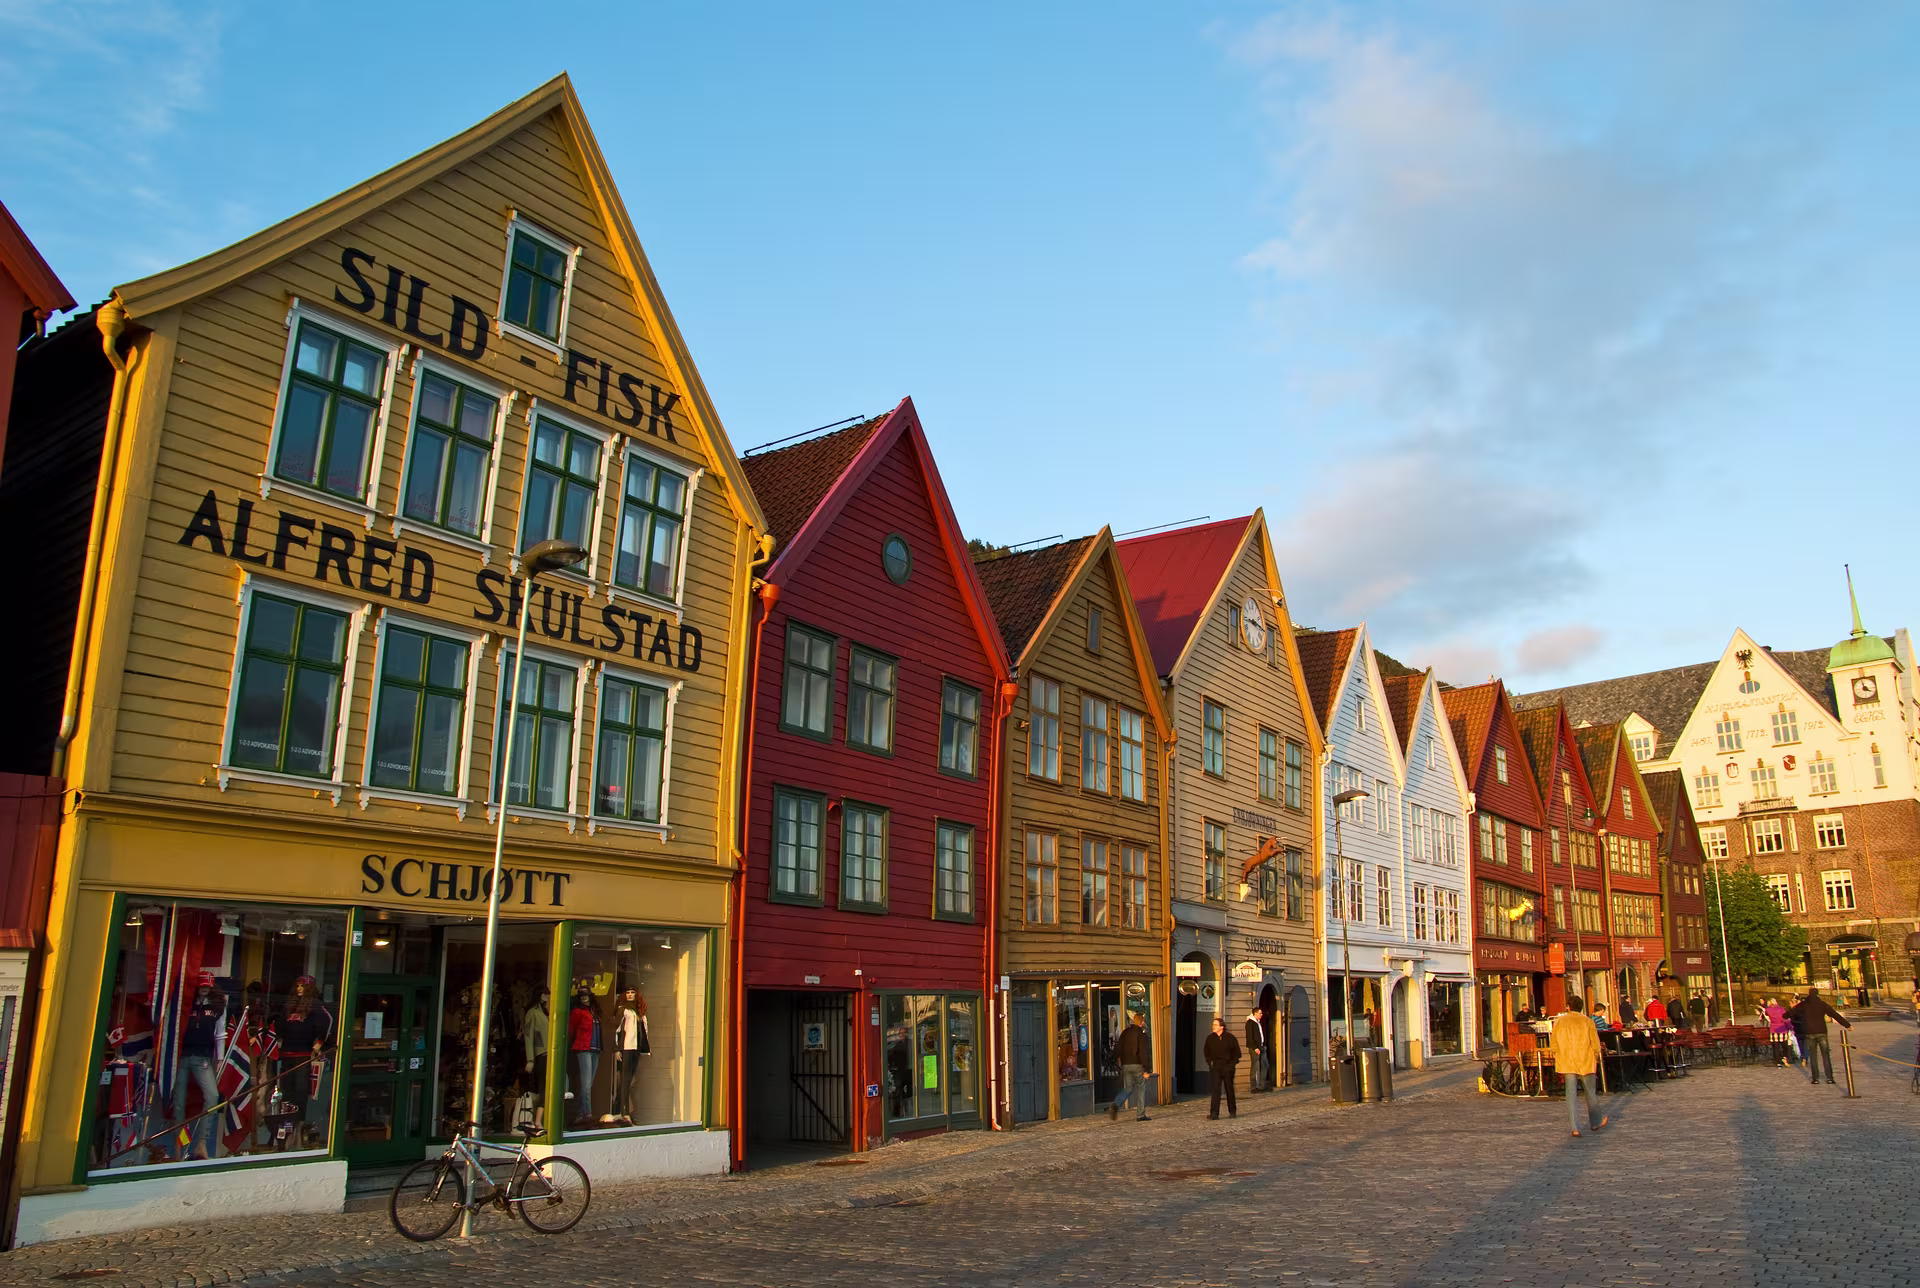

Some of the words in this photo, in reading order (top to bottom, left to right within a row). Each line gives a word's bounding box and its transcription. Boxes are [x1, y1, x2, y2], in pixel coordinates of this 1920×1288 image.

[334, 246, 489, 362] SILD
[562, 348, 682, 444] FISK
[177, 489, 435, 605] ALFRED
[473, 568, 703, 673] SKULSTAD
[361, 854, 571, 907] SCHJØTT
[1245, 936, 1287, 956] SJØBODEN
